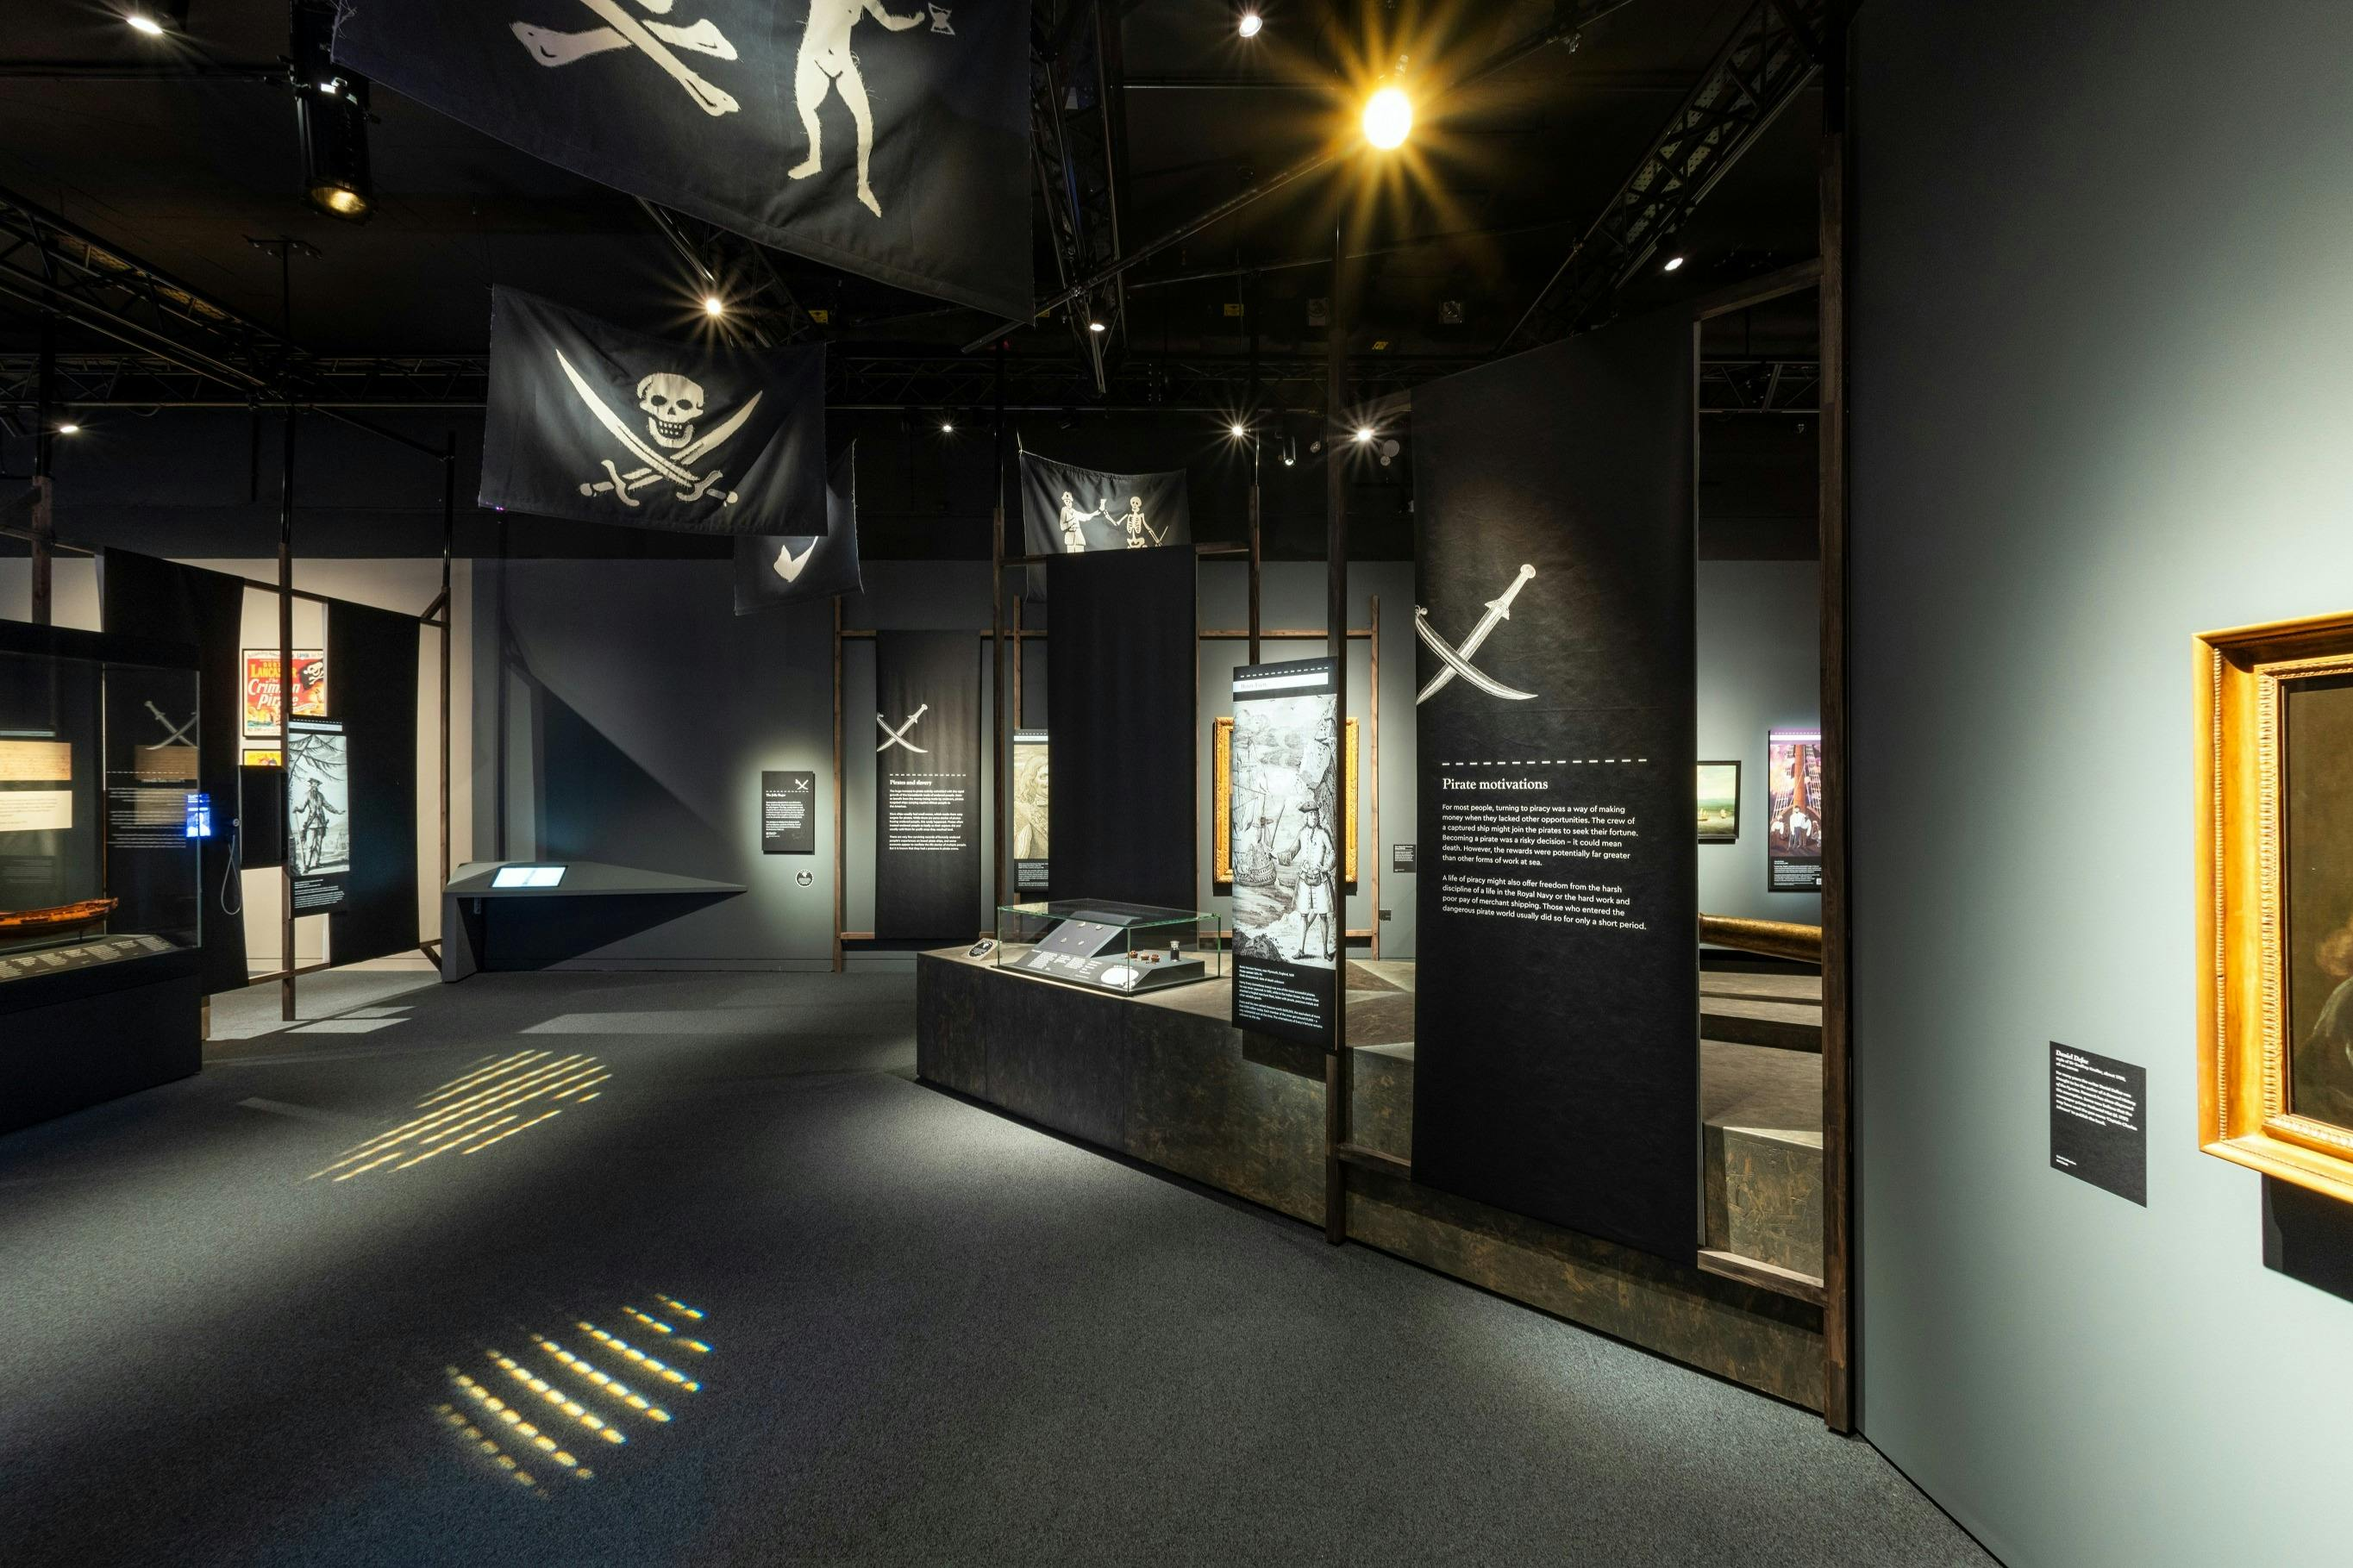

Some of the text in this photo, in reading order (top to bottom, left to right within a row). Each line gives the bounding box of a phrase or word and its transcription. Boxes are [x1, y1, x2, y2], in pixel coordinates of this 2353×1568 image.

[248, 679, 300, 696] Crimn
[1442, 778, 1549, 790] Pirate motivations
[1470, 803, 1494, 812] people,
[1495, 804, 1519, 813] turning
[1530, 804, 1551, 814] piracy
[1599, 805, 1625, 815] making
[1541, 815, 1590, 824] opportunities.
[1627, 816, 1636, 825] of
[1491, 825, 1511, 834] might
[1511, 826, 1524, 834] join
[1538, 826, 1562, 834] pirates
[1609, 828, 1638, 837] fortune.
[1442, 834, 1474, 843] Becoming
[1519, 836, 1536, 846] risky
[1463, 846, 1493, 854] However,
[1552, 849, 1590, 859] potentially
[1475, 855, 1493, 864] forms
[1467, 876, 1486, 884] piracy
[1486, 878, 1506, 886] might
[1539, 880, 1568, 890] freedom
[1569, 882, 1586, 890] from
[1587, 884, 1600, 892] the
[1602, 884, 1623, 893] harsh
[1442, 884, 1472, 893] discipline
[1517, 890, 1536, 899] Royal
[1536, 891, 1554, 901] Navy
[1578, 894, 1594, 903] hard
[1479, 898, 1510, 907] merchant
[1511, 900, 1542, 910] shipping.
[1542, 903, 1564, 911] Those
[1564, 904, 1581, 913] who
[1581, 907, 1611, 915] entered
[1612, 908, 1625, 916] the
[1442, 905, 1475, 914] dangerous
[1516, 912, 1539, 921] usually
[1563, 915, 1574, 923] for
[1574, 916, 1591, 926] only
[1599, 918, 1618, 928] short
[1619, 921, 1647, 930] period.
